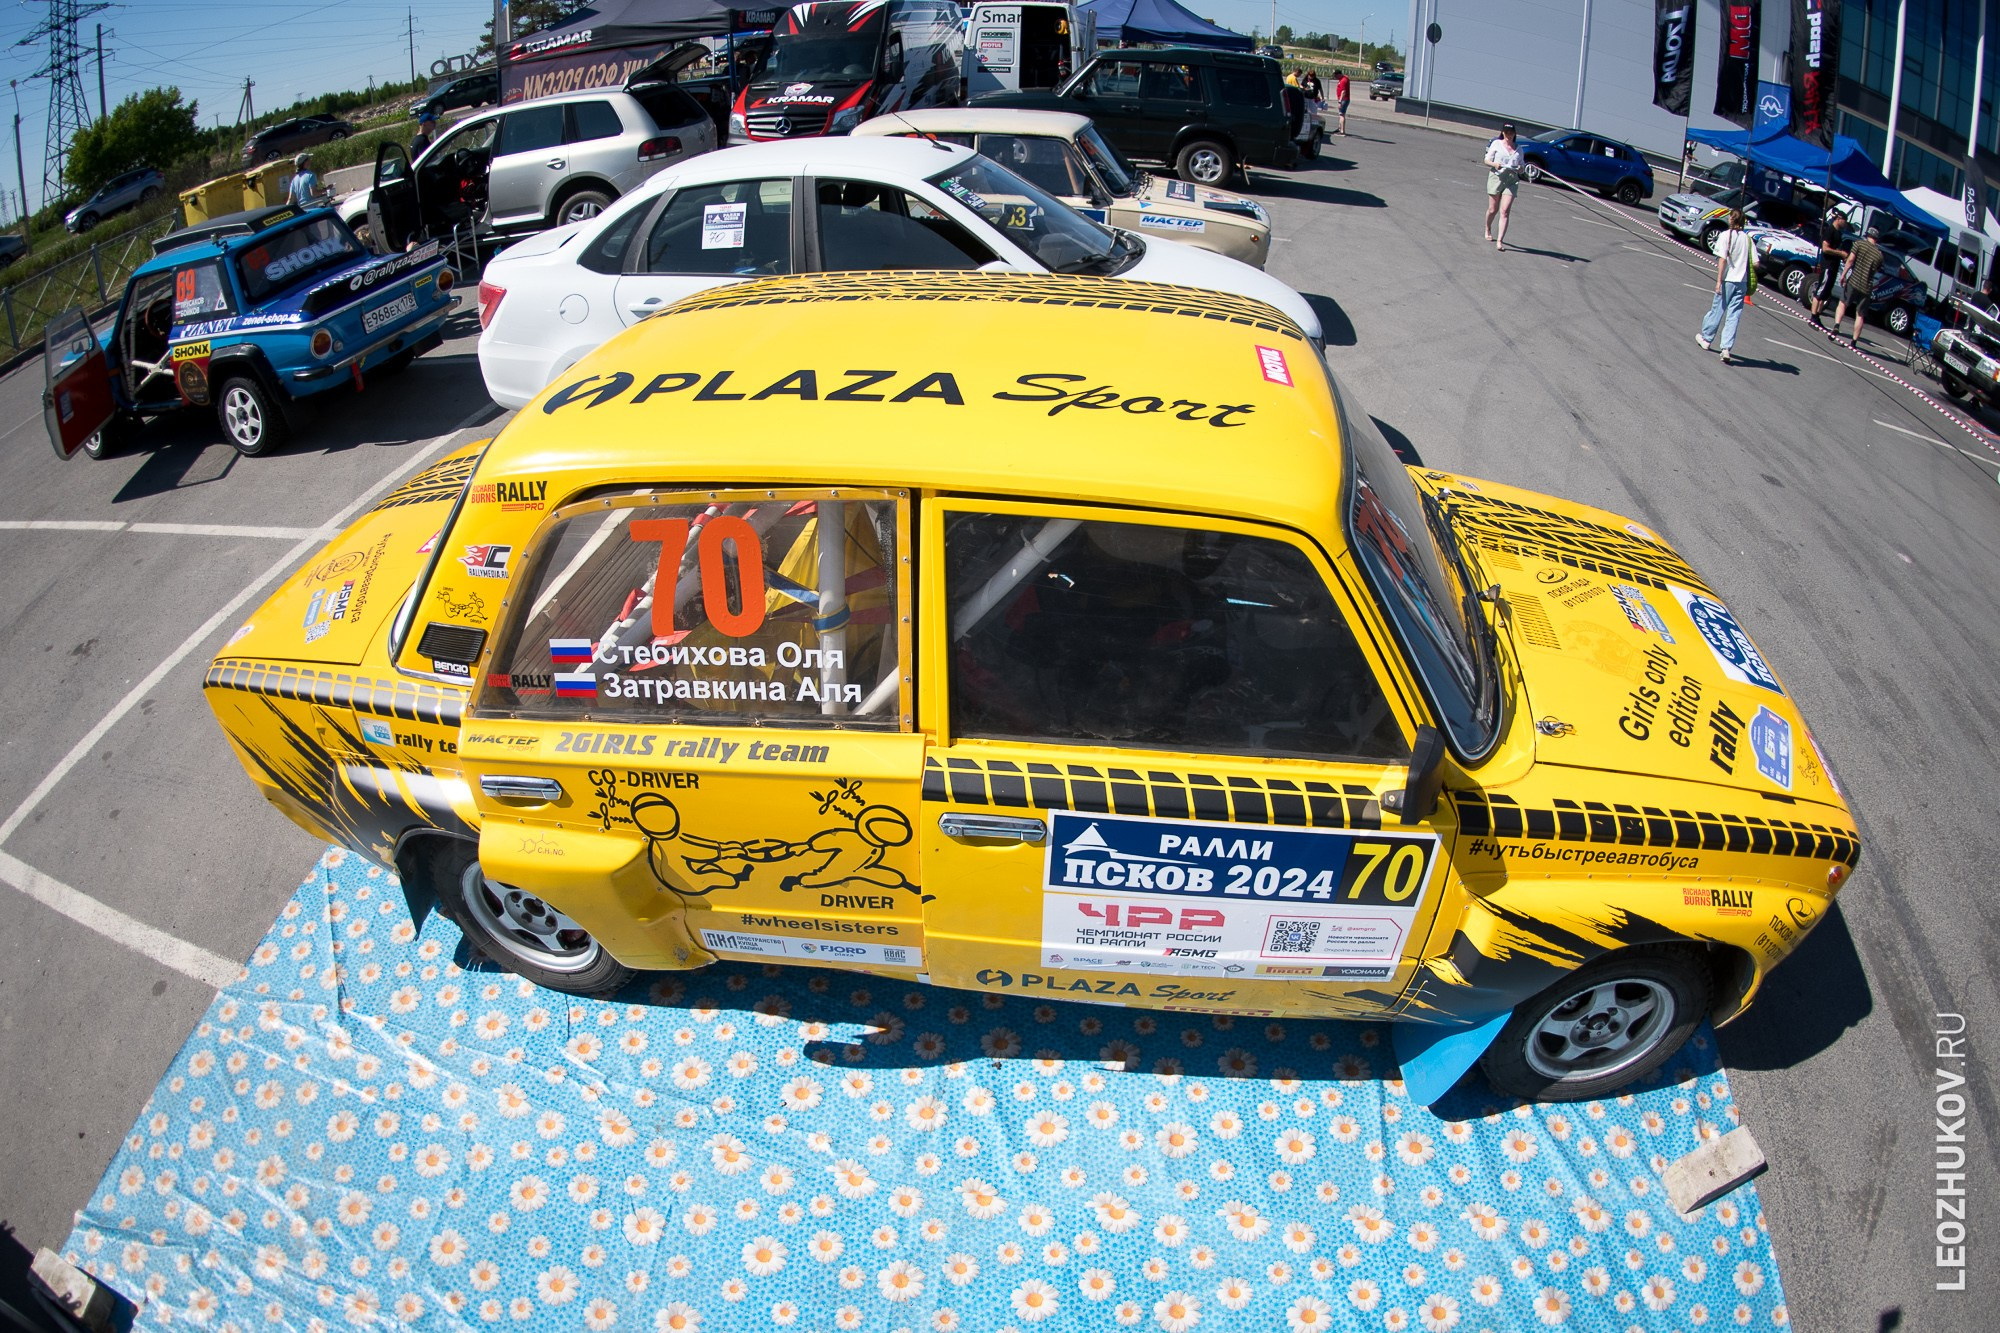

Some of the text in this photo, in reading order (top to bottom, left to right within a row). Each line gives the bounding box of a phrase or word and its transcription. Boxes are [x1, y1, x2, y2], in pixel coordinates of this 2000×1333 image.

[525, 29, 593, 54] KRAMAR
[767, 95, 835, 104] KRAMAR
[1141, 215, 1204, 227] МАСТЕР
[177, 268, 196, 302] 69
[366, 294, 415, 328] Е968ЕХ 178
[188, 317, 238, 337] ZENET
[174, 342, 209, 359] SHONX
[1257, 347, 1291, 385] MOTUL
[630, 370, 1256, 427] PLAZA Sport
[471, 493, 497, 503] BURNS
[472, 484, 496, 493] RICHARD
[497, 480, 548, 502] RALLY
[525, 502, 545, 511] PRO
[629, 515, 766, 638] 70
[333, 582, 355, 621] ASMG
[1697, 597, 1736, 626] 70
[599, 639, 844, 669] Стебихова Оля
[434, 660, 469, 674] BENGIO
[511, 674, 551, 688] RALLY
[604, 673, 862, 705] Затравкина Аля
[1619, 685, 1661, 741] Girls
[1643, 643, 1678, 685] only
[1667, 675, 1703, 748] edition
[395, 732, 433, 753] rally
[467, 733, 540, 746] МАСТЕР
[554, 731, 830, 764] 2GIRLS rally team
[1709, 700, 1746, 776] rally
[1158, 834, 1274, 861] РАЛЛИ
[1469, 838, 1699, 870] #чутьбыстрееавтобуса
[1063, 857, 1333, 899] ПСКОВ 2024
[1346, 842, 1425, 902] 70
[820, 894, 894, 910] DRIVER
[1682, 887, 1711, 896] RICHARD
[1684, 896, 1711, 906] BURNS
[1711, 889, 1753, 909] RALLY
[1078, 902, 1226, 931] ЧРР
[1736, 909, 1752, 917] PRO
[740, 913, 900, 936] #wheelsisters
[736, 935, 781, 945] ПРОСТРАНСТВО
[1076, 936, 1146, 948] ПО РАЛЛИ
[1077, 928, 1222, 943] ЧЕМПИОНАТ РОССИИ
[820, 944, 867, 955] FJORD
[1168, 947, 1219, 958] ASMG
[1265, 965, 1313, 974] PIRELLI
[1021, 973, 1238, 1002] PLAZA Sport
